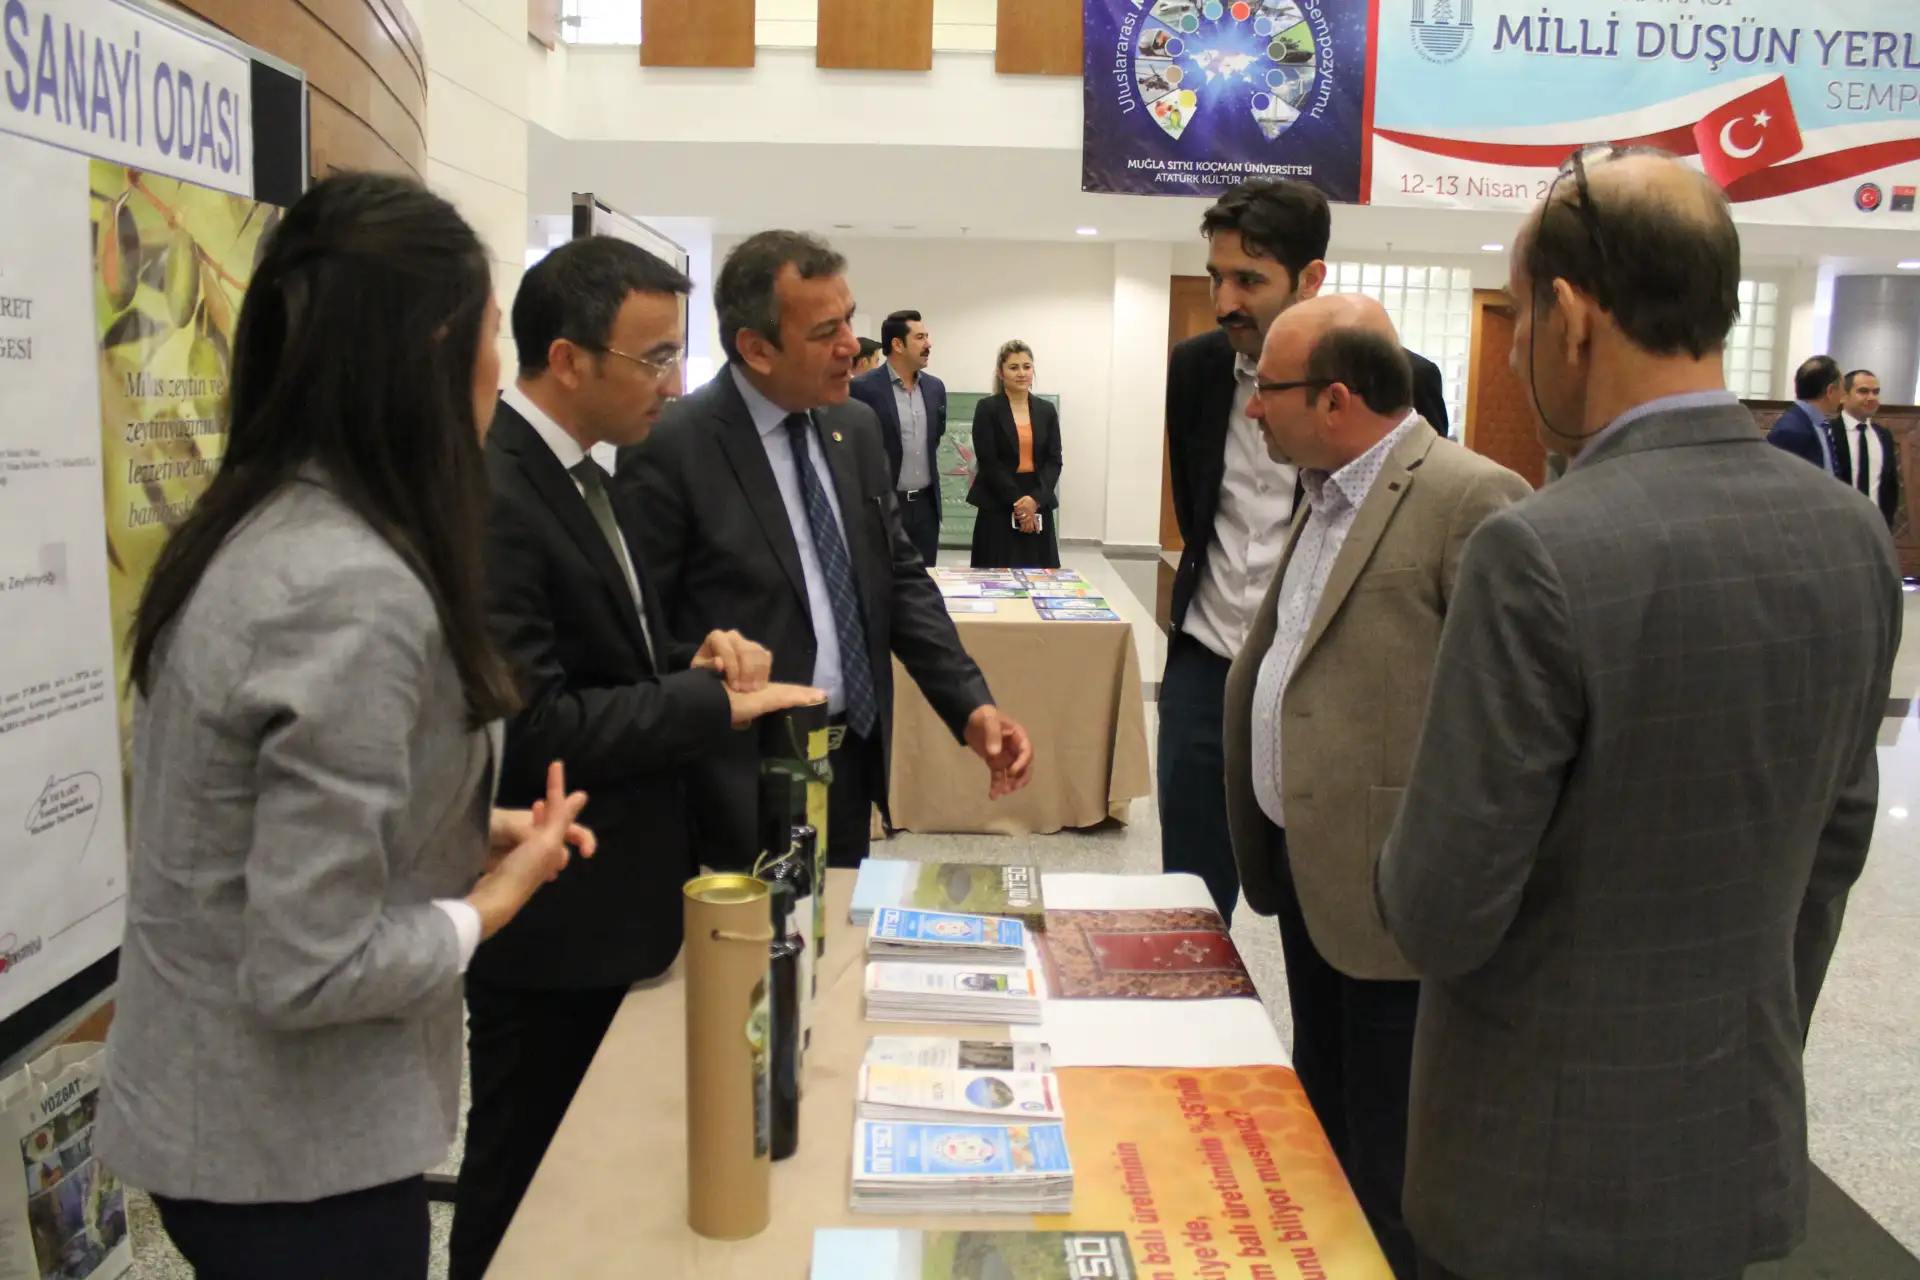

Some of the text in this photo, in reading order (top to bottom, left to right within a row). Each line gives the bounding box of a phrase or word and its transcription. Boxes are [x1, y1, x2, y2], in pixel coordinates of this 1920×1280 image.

[1493, 7, 1620, 56] MİLLİ
[1635, 14, 1801, 71] DÜŞÜN
[1113, 12, 1138, 114] Uluslararası
[3, 0, 241, 175] SANAYİ ODASI
[1826, 80, 1920, 112] SEMP
[1127, 158, 1313, 176] MUĞLA SITKI KOÇMAN ÜNİVERSİTESİ
[1154, 171, 1199, 184] ATATÜRK
[1201, 173, 1240, 185] KÜLTÜR
[1400, 173, 1460, 196] 12-13
[1466, 176, 1529, 199] Nisan
[1263, 1187, 1310, 1243] biliyor
